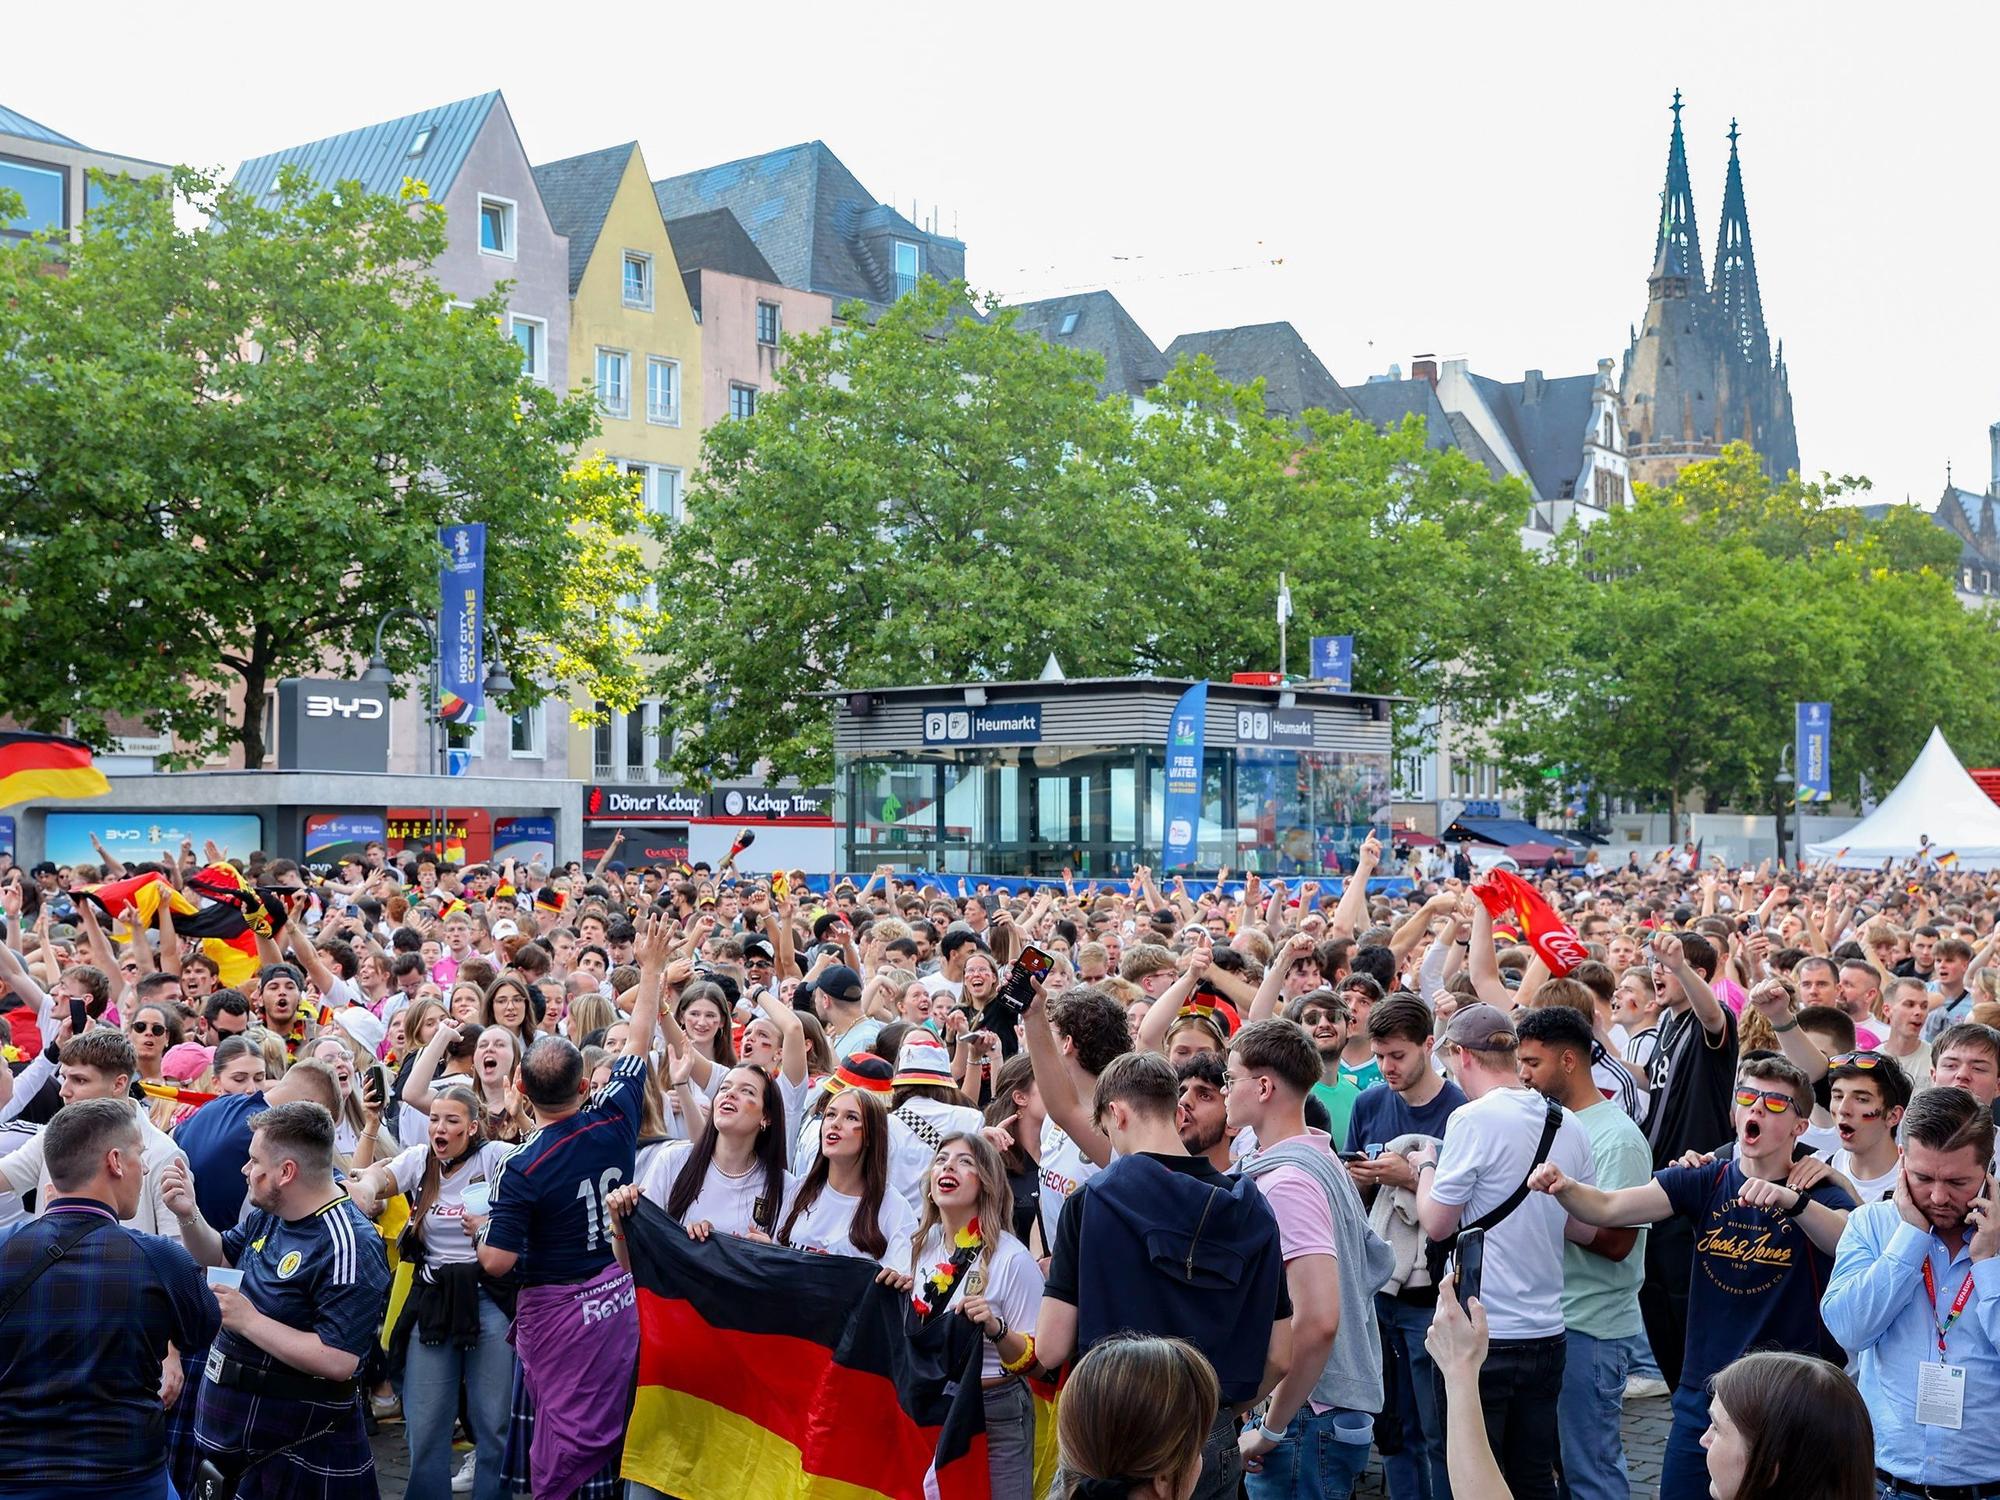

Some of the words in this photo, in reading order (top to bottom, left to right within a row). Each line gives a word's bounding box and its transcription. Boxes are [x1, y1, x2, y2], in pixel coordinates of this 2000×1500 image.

[459, 610, 468, 643] CITY
[465, 589, 476, 683] COLOGNE
[459, 644, 468, 684] HOST
[306, 695, 384, 719] BYD
[976, 715, 1036, 732] Heumarkt
[1273, 720, 1312, 735] Heumarkt
[1174, 756, 1194, 767] FREE
[1168, 767, 1198, 778] WATER
[608, 793, 655, 812] Döner
[790, 795, 822, 812] Tim
[106, 829, 140, 840] BYD
[387, 828, 468, 838] MPERIVM
[1650, 1055, 1670, 1090] 18
[1038, 1166, 1077, 1197] HECK2
[1712, 1198, 1793, 1235] AUTNTIC
[1728, 1221, 1768, 1232] established
[1697, 1226, 1738, 1252] Jack
[1732, 1240, 1750, 1257] &
[1742, 1232, 1792, 1262] Jones
[1730, 1262, 1748, 1271] 1990
[1714, 1278, 1744, 1295] CRAFTED
[1746, 1282, 1772, 1295] DENIM
